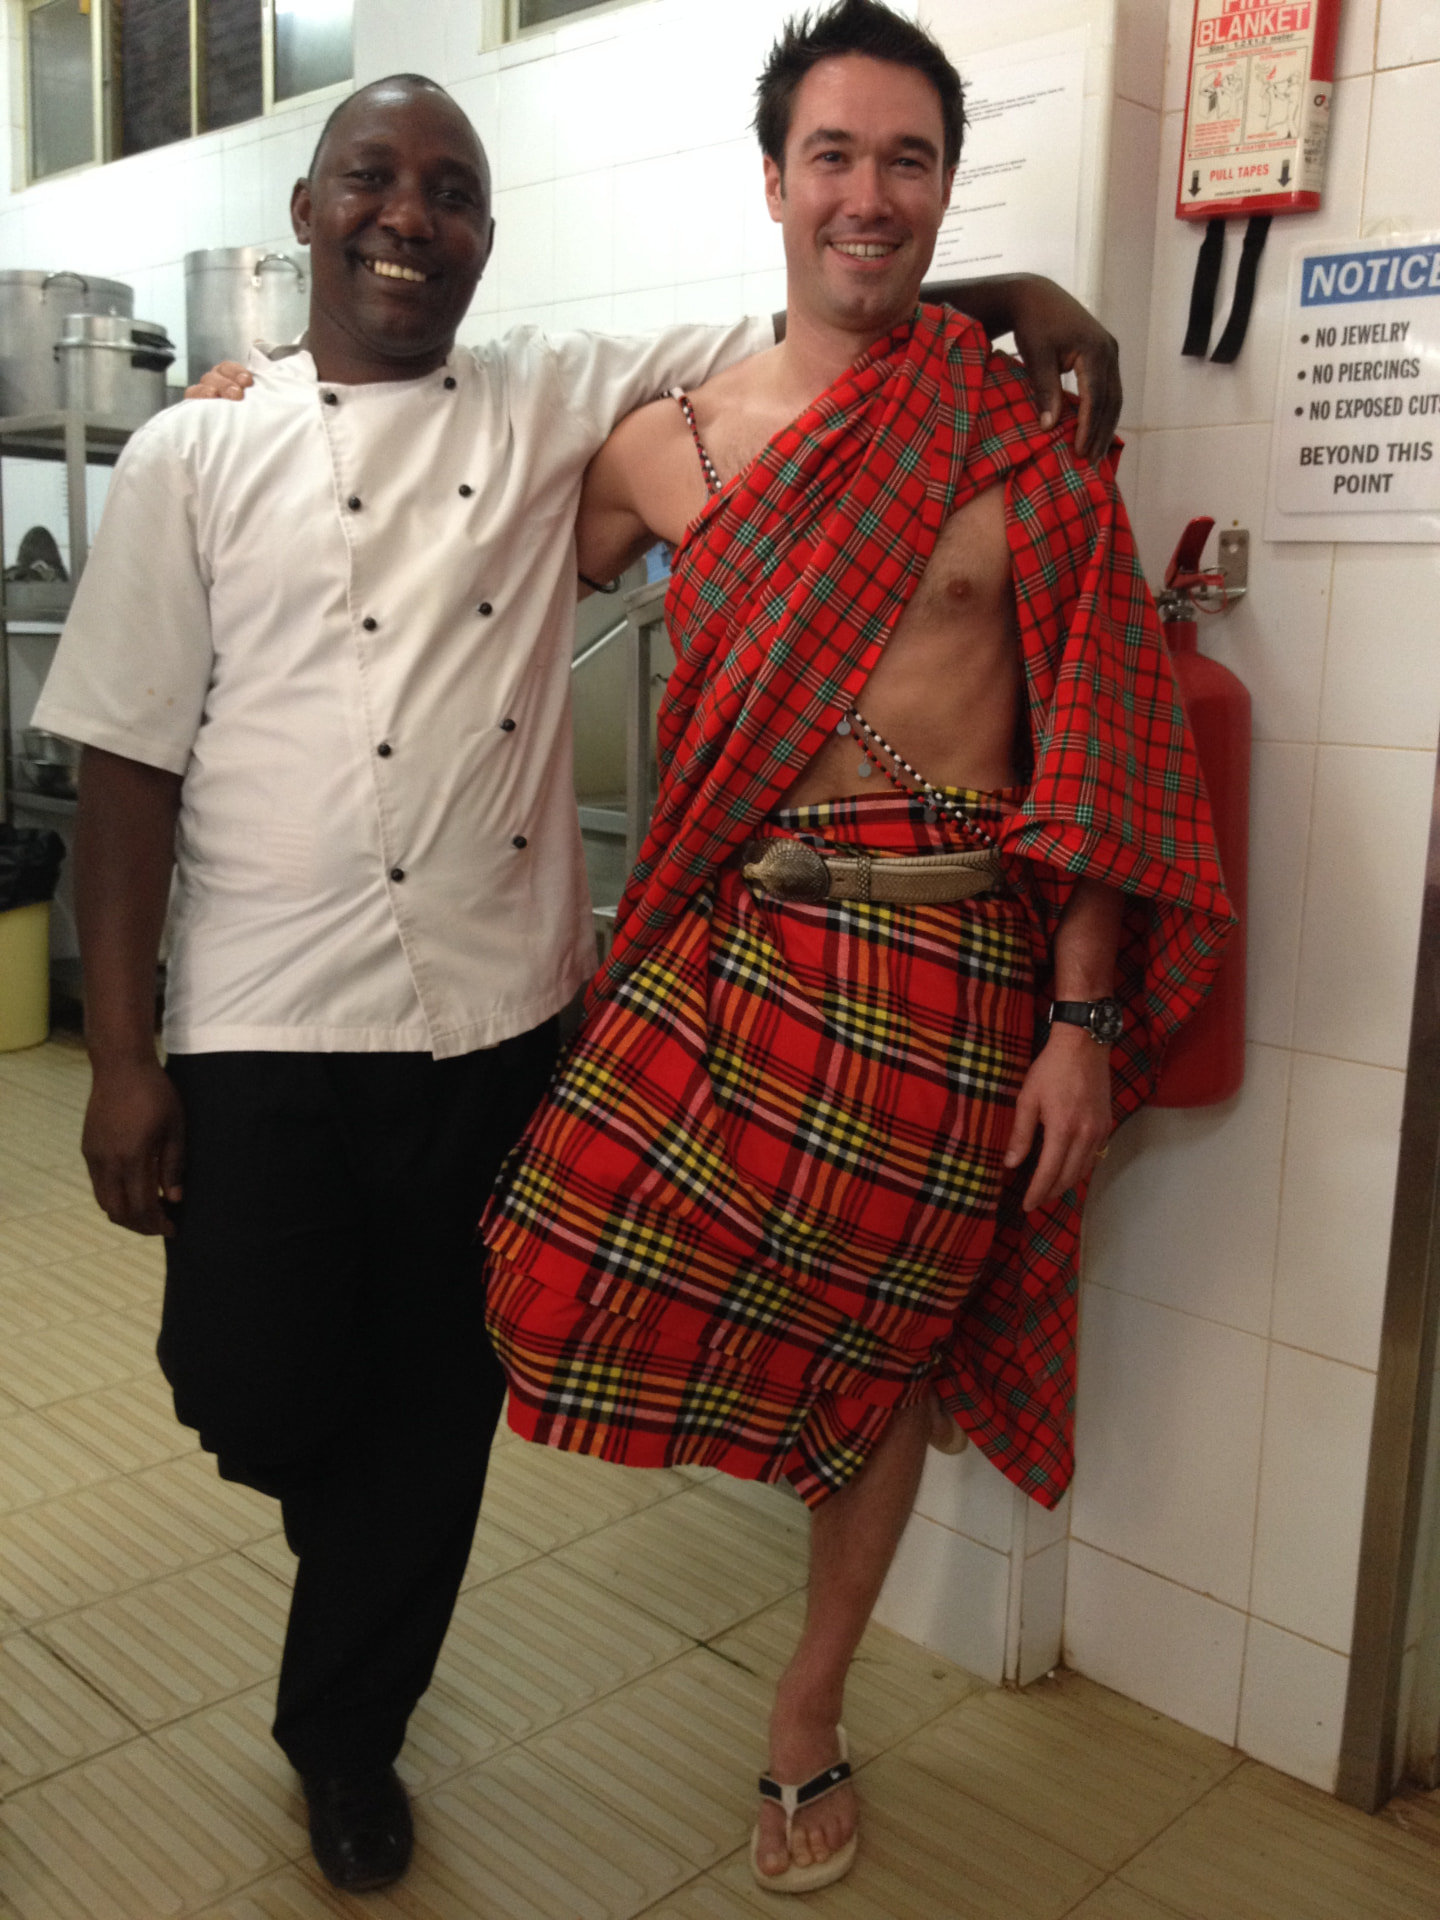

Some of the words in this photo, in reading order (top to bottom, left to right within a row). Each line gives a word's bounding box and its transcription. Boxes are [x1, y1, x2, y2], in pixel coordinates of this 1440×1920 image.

[1199, 3, 1309, 45] BLANKET
[1209, 168, 1233, 182] PULL
[1237, 164, 1270, 179] TAPES
[1315, 327, 1337, 348] NO
[1340, 321, 1410, 347] JEWELRY
[1312, 364, 1334, 384] NO
[1338, 358, 1421, 383] PIERCINGS
[1309, 400, 1331, 420] NO
[1334, 396, 1403, 419] EXPOSED
[1408, 393, 1440, 416] CUT
[1299, 444, 1380, 466] BEYOND
[1386, 441, 1433, 463] THIS
[1333, 473, 1394, 494] POINT
